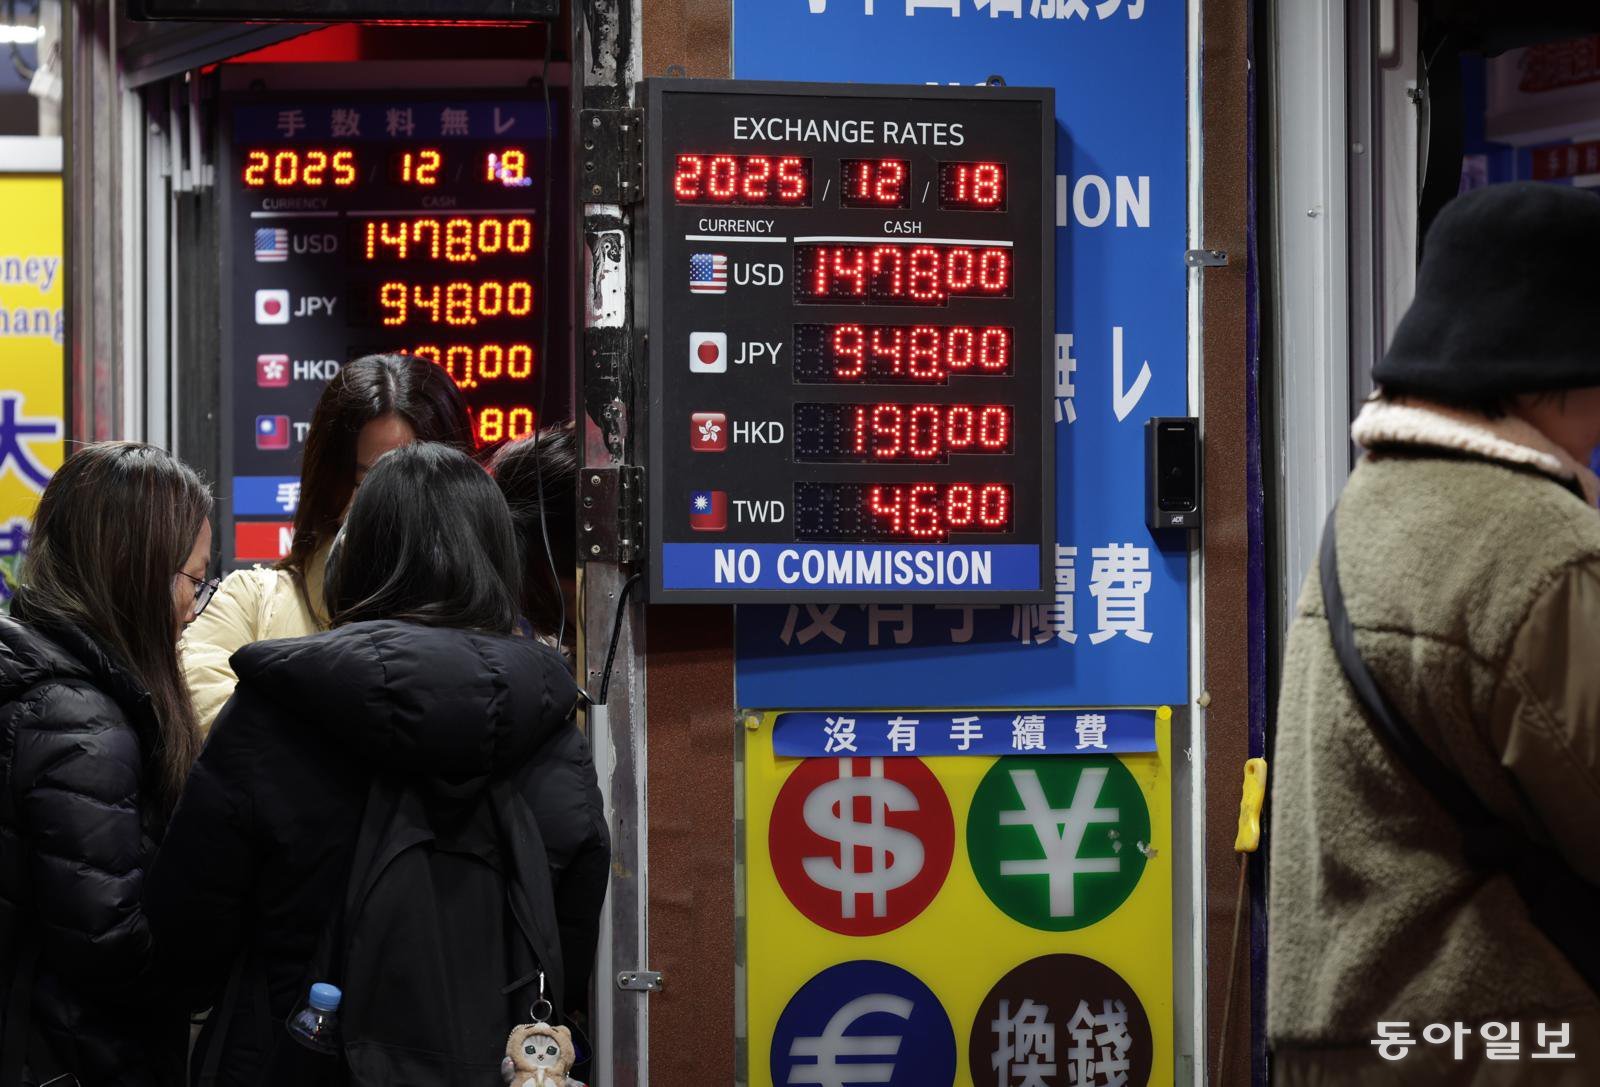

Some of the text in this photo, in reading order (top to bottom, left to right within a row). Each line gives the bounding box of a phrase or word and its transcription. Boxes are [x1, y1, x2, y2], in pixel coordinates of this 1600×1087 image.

[733, 117, 965, 146] EXCHANGE RATES
[244, 150, 356, 187] 2025
[401, 150, 442, 186] 12
[486, 149, 527, 187] 18
[675, 155, 803, 198] 2025
[860, 161, 902, 201] 12
[958, 163, 1000, 203] 18
[262, 197, 456, 210] CURRENCY CASH
[293, 235, 338, 254] USD
[699, 218, 922, 235] CURRENCY CASH
[0, 257, 58, 291] ney
[733, 263, 784, 286] USD
[294, 281, 532, 326] JPY 948.00
[733, 325, 1007, 378] JPY 948.00
[294, 360, 340, 381] HKD
[733, 422, 785, 444] HKD
[733, 485, 1007, 537] TWD 46.80
[714, 549, 992, 585] NO COMMISSION
[823, 713, 1109, 754] 沒有手續費
[801, 757, 926, 919] $
[999, 767, 1120, 917] ¥
[786, 993, 915, 1087] €
